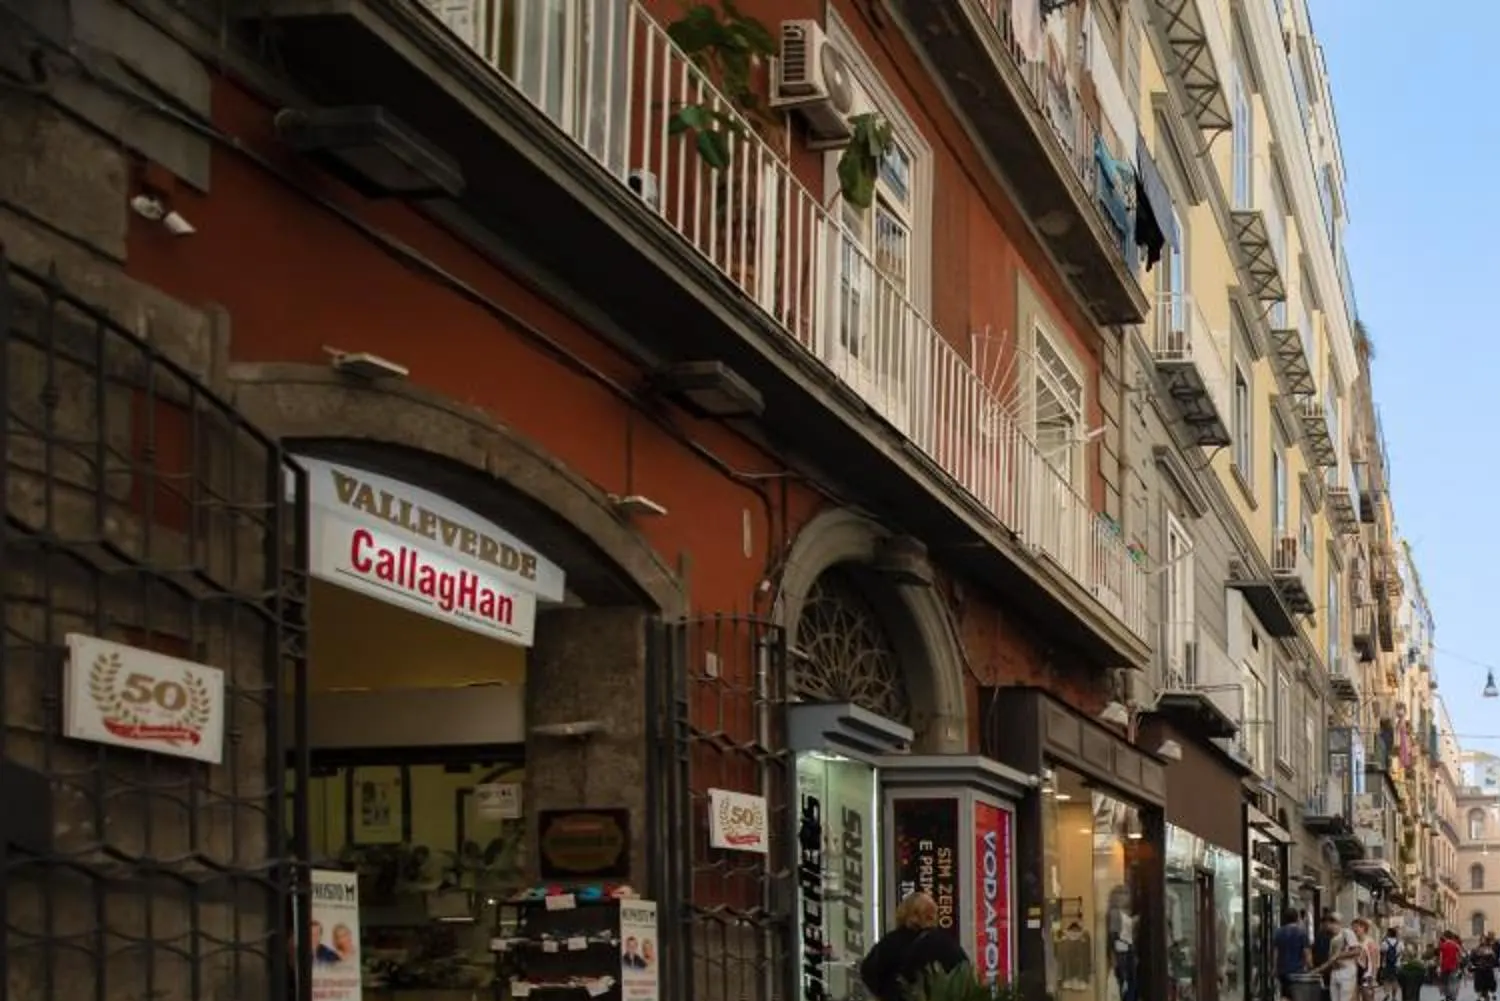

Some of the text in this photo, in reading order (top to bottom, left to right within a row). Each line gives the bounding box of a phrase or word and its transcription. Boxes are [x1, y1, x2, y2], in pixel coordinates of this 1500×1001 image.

[331, 469, 537, 580] VALLEVERDE
[351, 528, 513, 625] CallagHan
[121, 673, 187, 711] 50
[731, 806, 754, 826] 50
[937, 847, 953, 929] SIM ZERO
[983, 830, 998, 998] VODAFO
